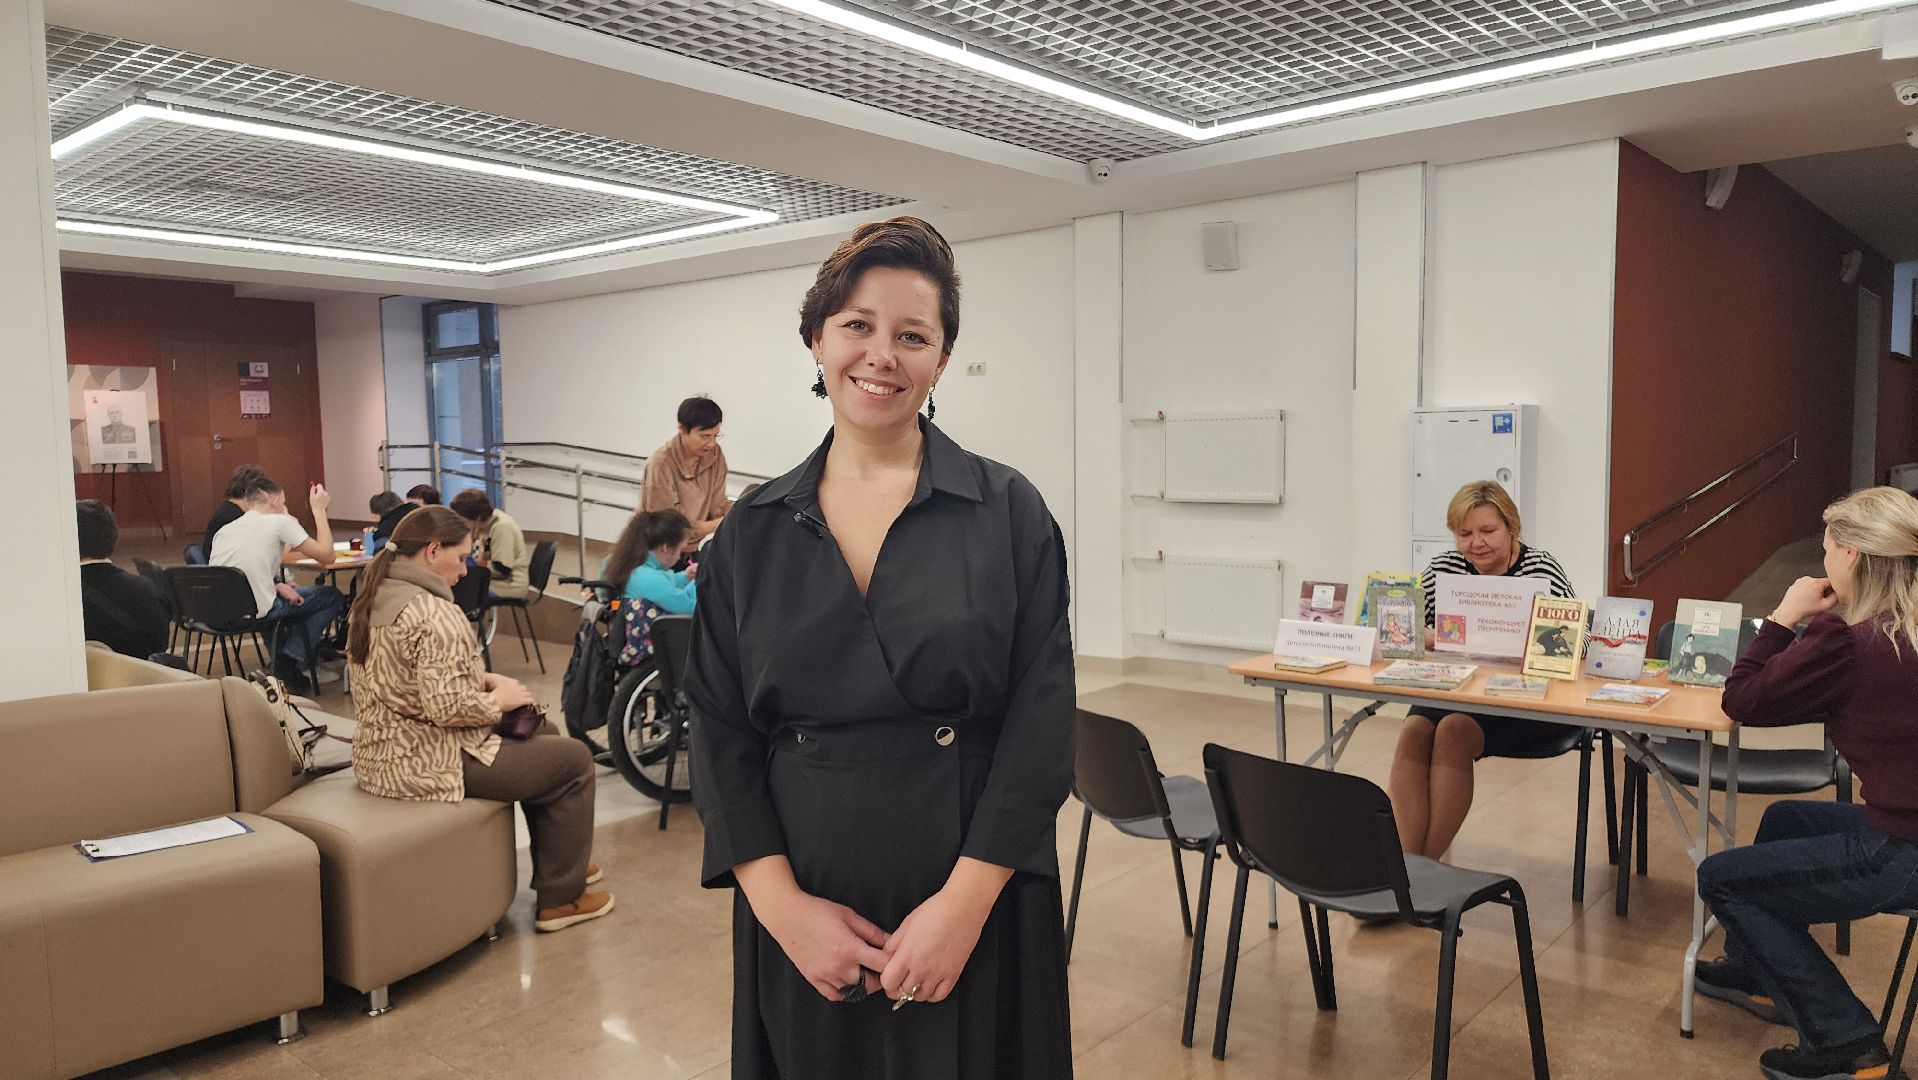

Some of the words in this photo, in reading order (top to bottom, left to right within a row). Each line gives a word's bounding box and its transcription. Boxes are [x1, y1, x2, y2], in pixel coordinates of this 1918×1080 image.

[1450, 590, 1489, 599] ГОРОДСКАЯ
[1491, 593, 1522, 601] ДЕТСКАЯ
[1458, 599, 1501, 607] БИБЛИОТЕКА
[1538, 607, 1580, 621] ГЮГО
[1477, 618, 1526, 627] РЕКОМЕНДУЕТ
[1604, 617, 1640, 629] АЛАЯ
[1297, 628, 1330, 638] ПОЛЕЗНЫЕ
[1331, 632, 1353, 640] КНИГИ
[1598, 626, 1641, 640] ЛЕНТА
